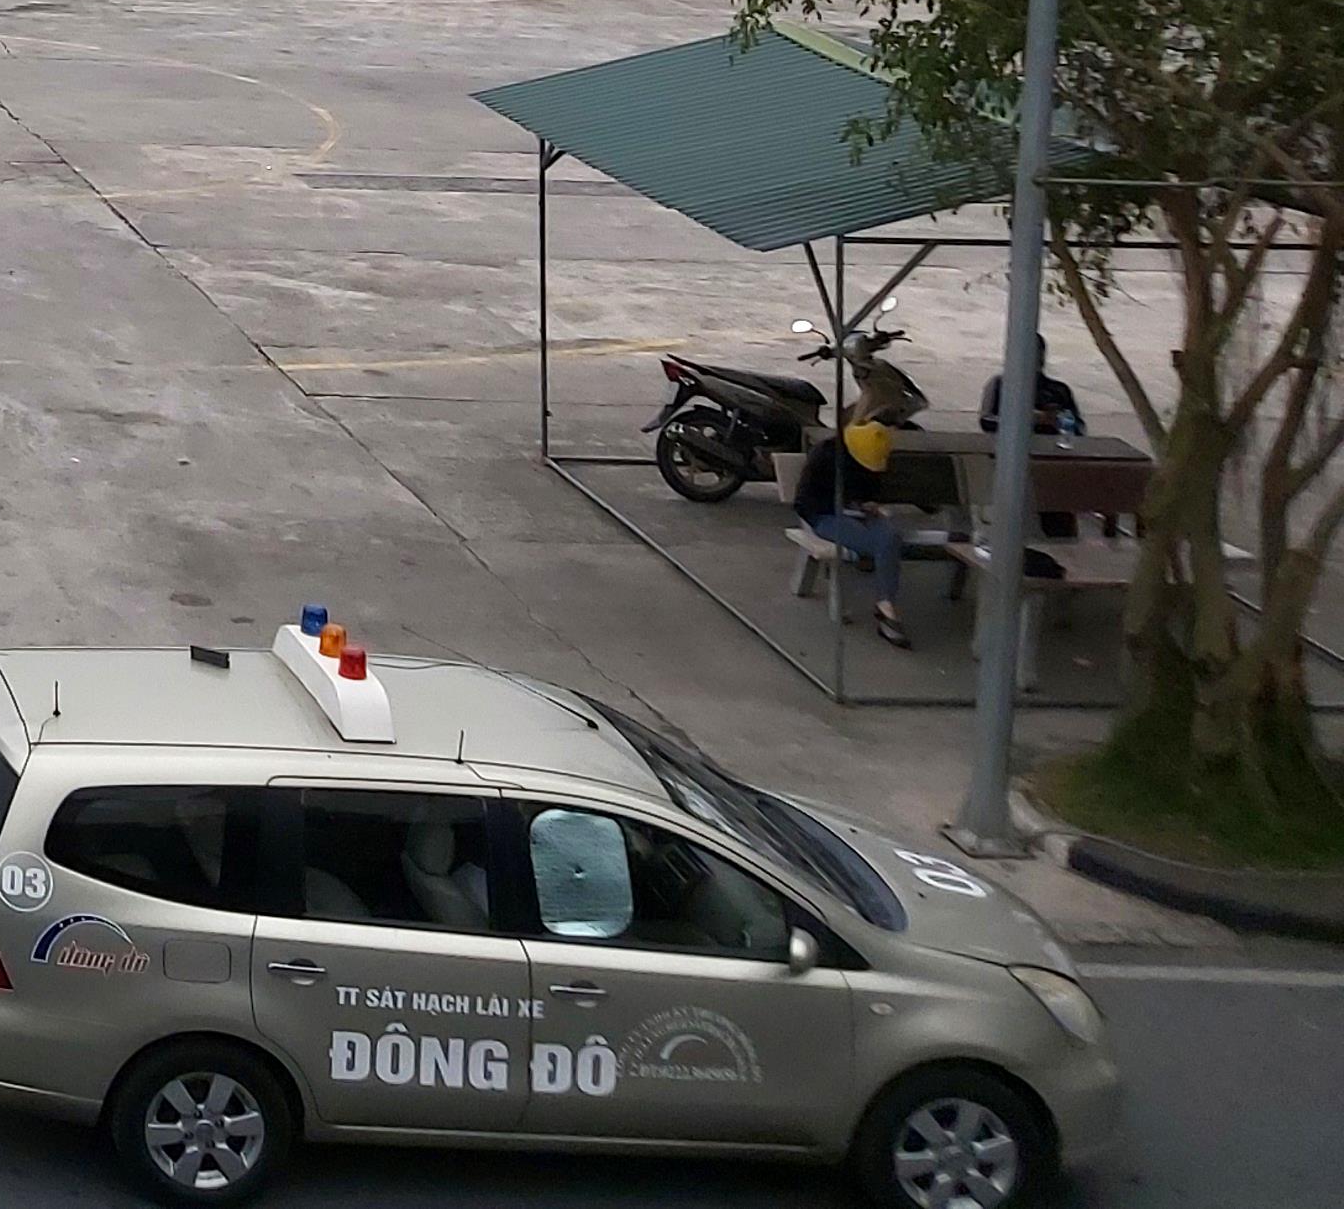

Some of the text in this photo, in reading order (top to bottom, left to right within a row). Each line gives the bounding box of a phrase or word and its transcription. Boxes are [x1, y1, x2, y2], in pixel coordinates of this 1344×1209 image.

[1, 864, 47, 899] 03
[892, 847, 988, 898] 03
[336, 985, 545, 1019] TT SÁT HẠCH LÁI XE
[328, 1021, 510, 1092] ĐÔNG
[529, 1033, 618, 1097] ĐÔ
